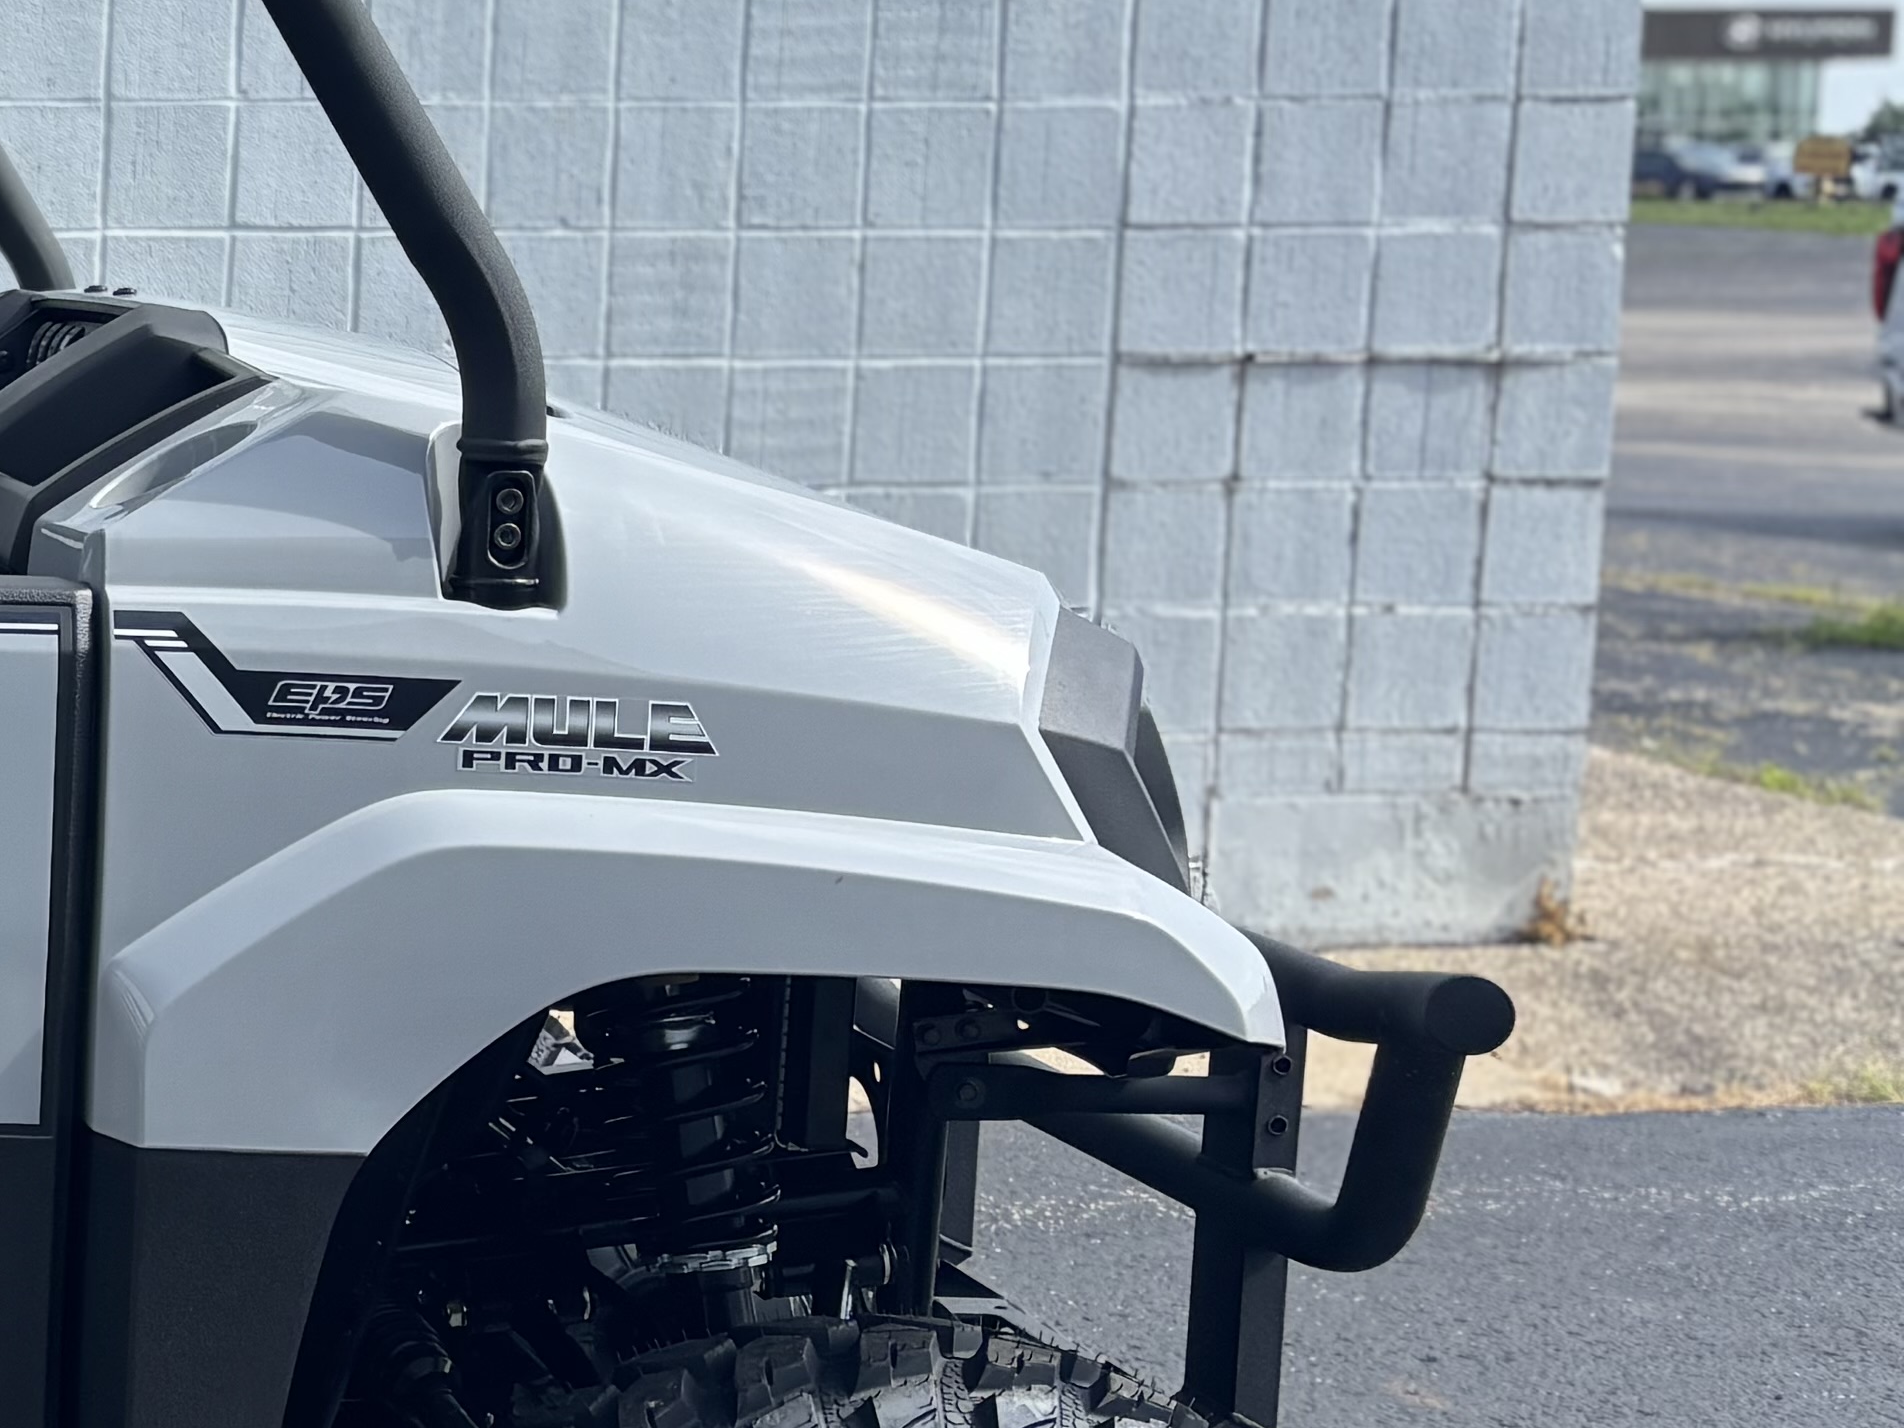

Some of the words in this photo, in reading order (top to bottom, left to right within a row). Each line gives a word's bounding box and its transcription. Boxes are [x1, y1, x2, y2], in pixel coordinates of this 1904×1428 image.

[267, 680, 394, 714] EPS
[437, 692, 719, 756] MULE
[458, 748, 693, 782] PRO-MX
